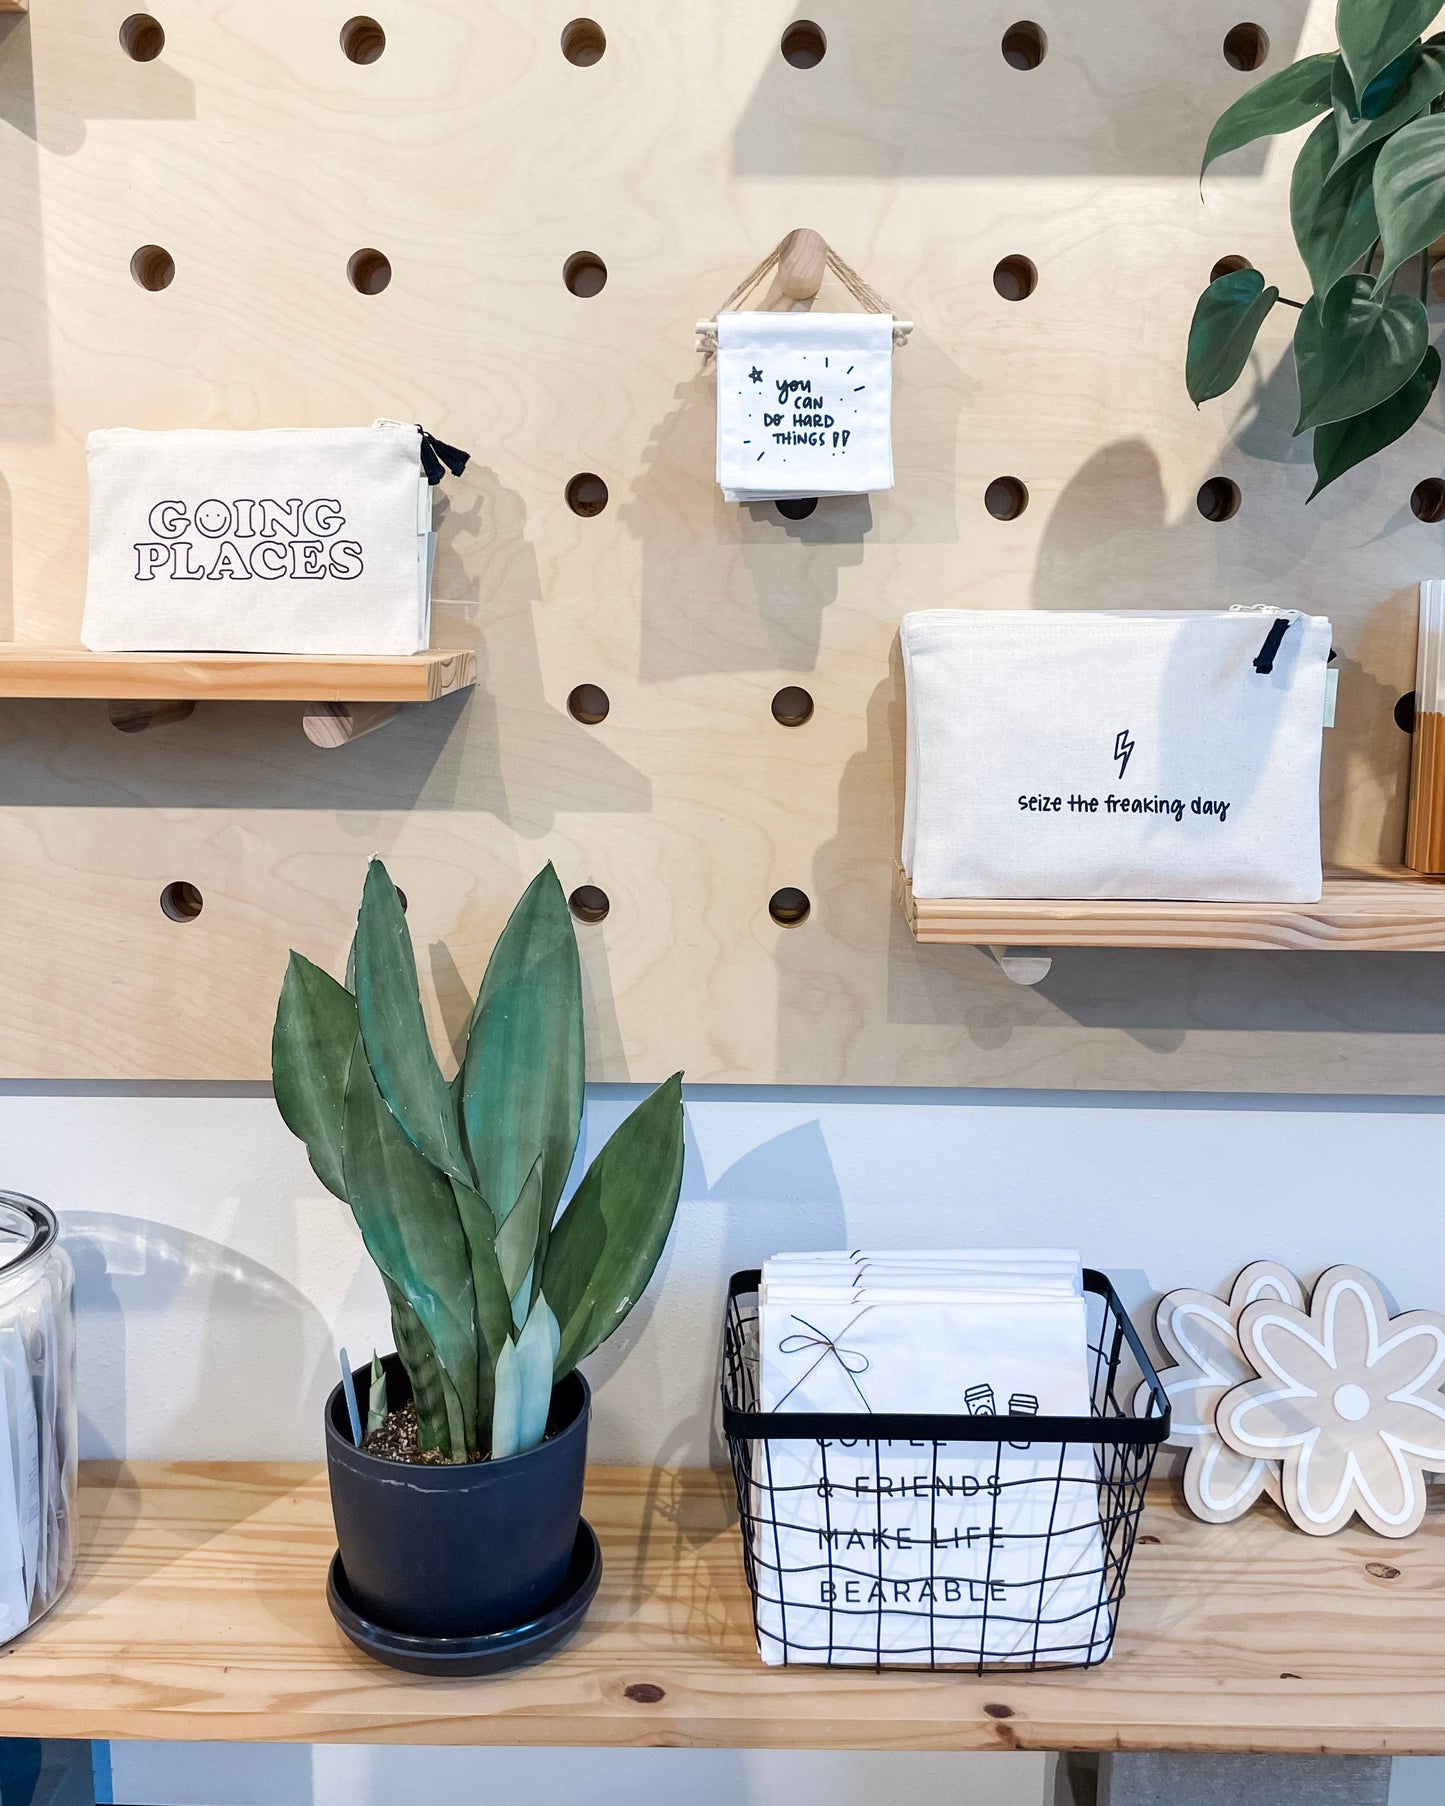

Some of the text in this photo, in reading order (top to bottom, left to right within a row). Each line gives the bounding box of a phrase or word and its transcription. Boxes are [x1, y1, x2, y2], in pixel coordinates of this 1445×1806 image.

[776, 379, 811, 405] you
[763, 412, 785, 427] DO
[149, 498, 346, 539] GOING
[133, 540, 364, 581] PLACES
[1018, 794, 1231, 822] seize the freaking day
[817, 1475, 1002, 1498] & FRIENDS
[818, 1526, 1005, 1550] MAKE LIFE
[820, 1579, 1007, 1603] BEARABLE
